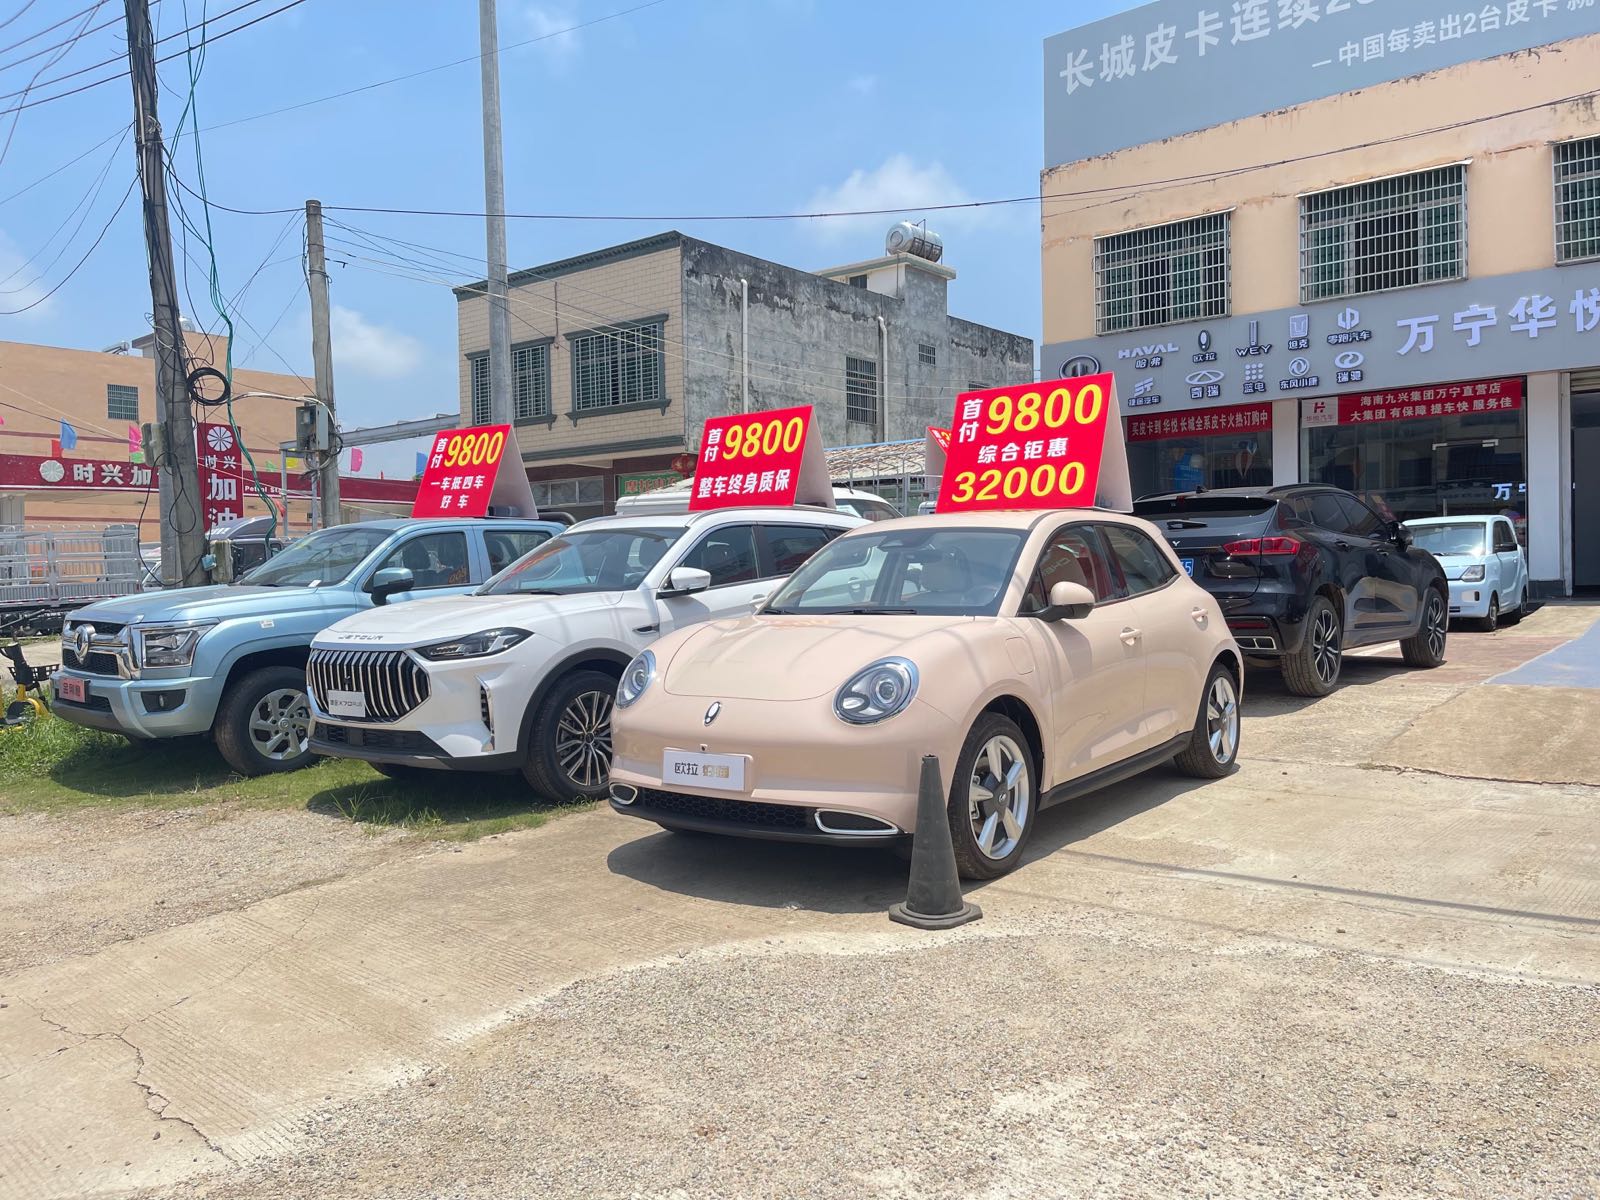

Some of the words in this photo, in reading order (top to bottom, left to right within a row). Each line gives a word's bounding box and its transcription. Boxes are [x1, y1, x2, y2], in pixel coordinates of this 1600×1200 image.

[1288, 339, 1309, 350] 坦克
[1327, 331, 1372, 345] 零跑汽车
[1118, 343, 1179, 359] HAVAL
[1193, 352, 1217, 363] 欧拉
[1236, 344, 1272, 357] WEY
[1135, 357, 1162, 369] 哈弗
[1280, 376, 1319, 390] 东风小康
[1337, 370, 1363, 384] 瑞驰
[1190, 384, 1220, 400] 奇瑞
[1243, 381, 1266, 394] 蓝电
[1360, 382, 1501, 406] 海南九兴集团万宁直营店
[958, 398, 983, 443] 首付
[986, 384, 1102, 435] 9800
[1350, 409, 1386, 422] 大集团
[1390, 405, 1427, 418] 有保障
[1430, 401, 1468, 414] 提车快
[1472, 397, 1513, 410] 服务佳
[704, 428, 722, 462] 首付
[722, 416, 804, 460] 9800
[430, 438, 448, 468] 首付
[444, 431, 503, 467] 9800
[977, 437, 1068, 464] 综合钜惠
[205, 454, 237, 469] 时兴
[73, 463, 159, 486] 时兴加
[431, 475, 485, 490] 一车抵四车
[697, 469, 790, 498] 整车终身质保
[952, 462, 1085, 503] 32000
[674, 762, 699, 776] 欧拉
